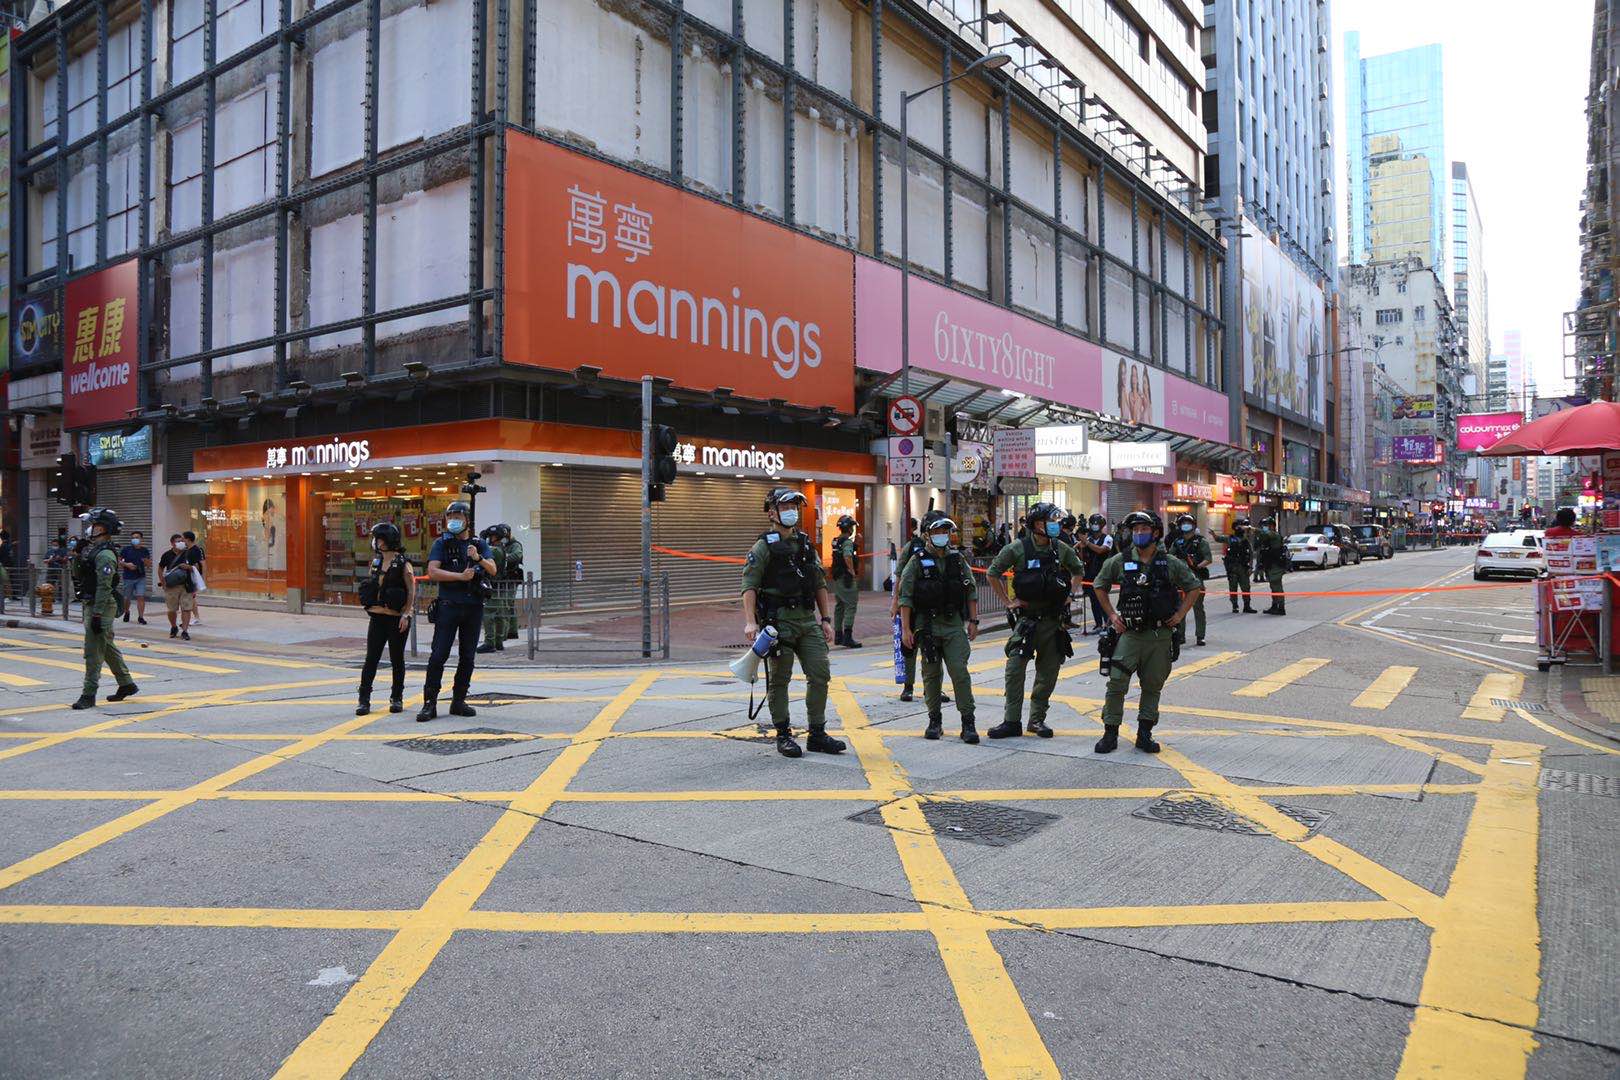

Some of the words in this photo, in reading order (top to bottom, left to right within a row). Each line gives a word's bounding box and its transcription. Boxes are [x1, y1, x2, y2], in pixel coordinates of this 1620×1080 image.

[567, 184, 653, 262] 萬寧
[73, 297, 126, 363] 惠康
[567, 262, 822, 379] mannings
[933, 311, 1056, 389] 6IXTY8IGHT
[70, 362, 130, 395] wellcome
[292, 437, 369, 467] mannings
[702, 445, 784, 476] mannings
[910, 459, 916, 468] 7
[911, 473, 922, 482] 12
